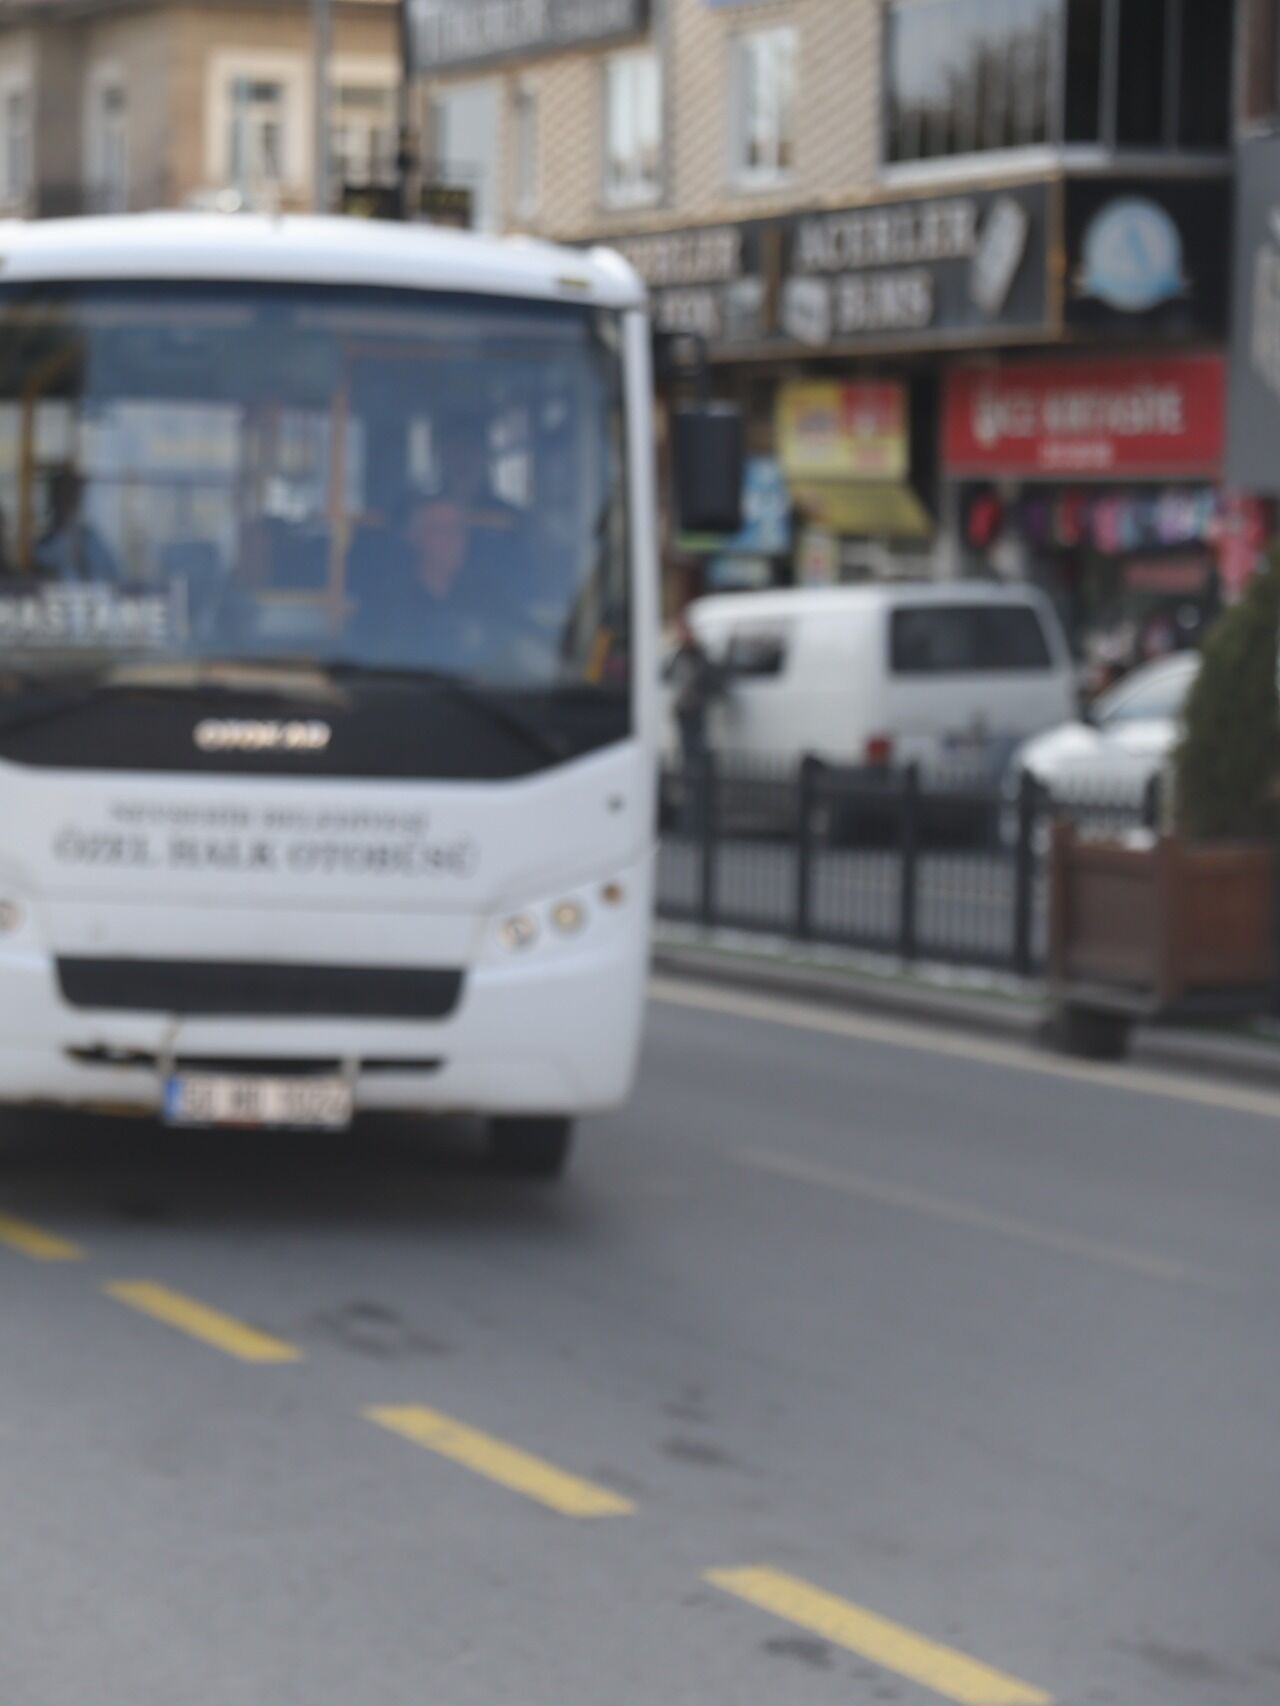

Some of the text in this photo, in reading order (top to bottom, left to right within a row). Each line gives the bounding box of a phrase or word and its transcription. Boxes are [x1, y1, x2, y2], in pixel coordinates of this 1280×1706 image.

[53, 826, 478, 877] ÖZEL HALK OTOBÜSÜ
